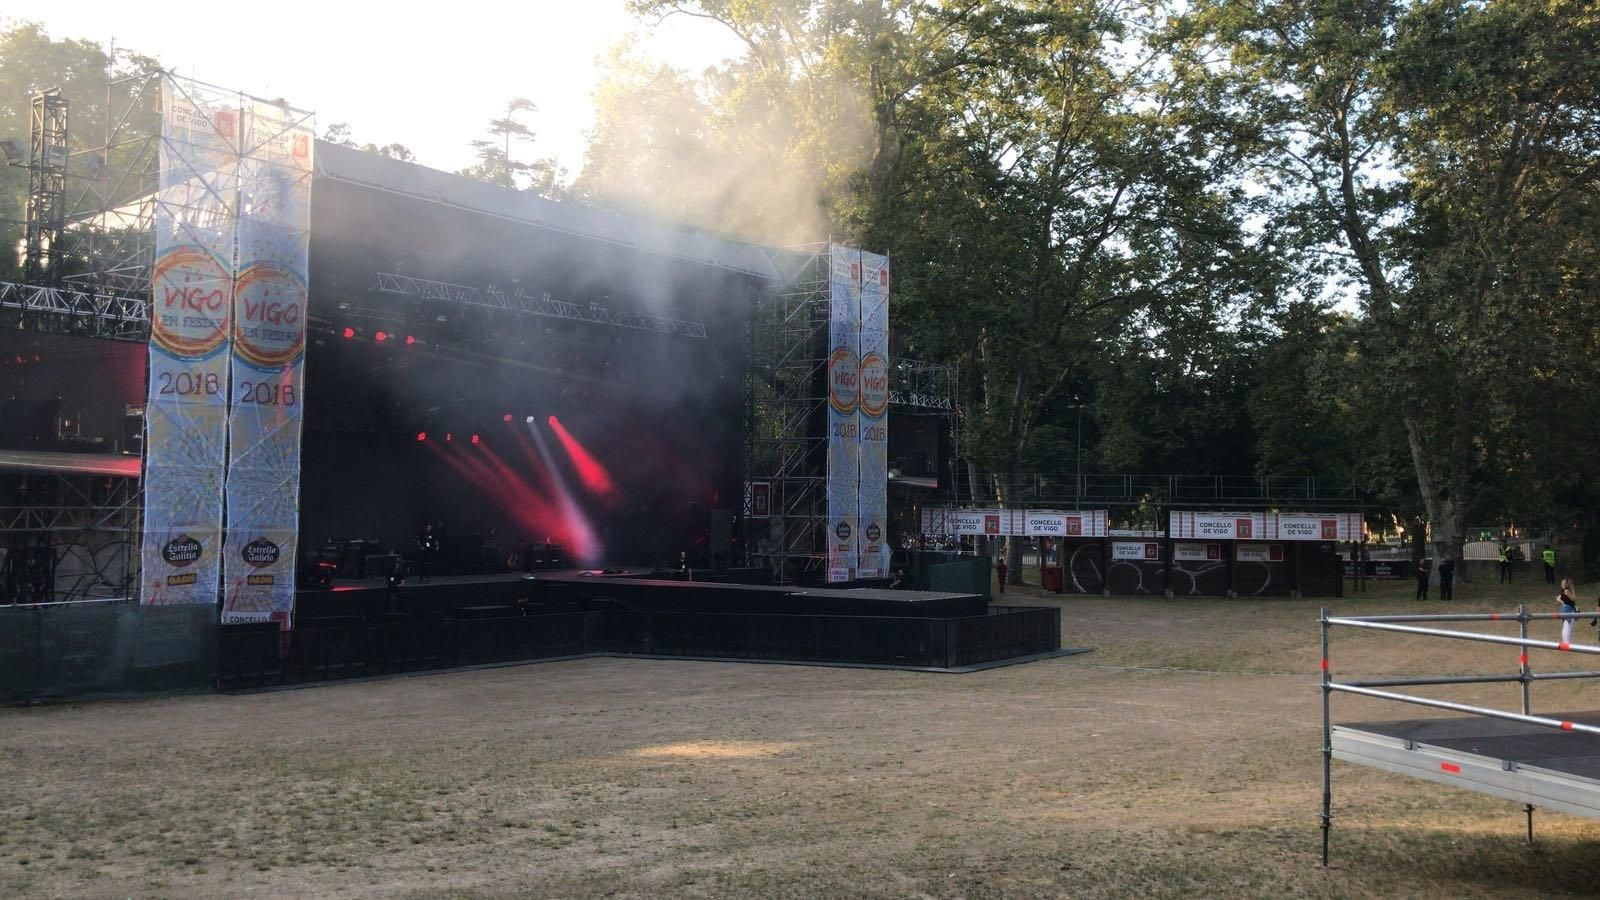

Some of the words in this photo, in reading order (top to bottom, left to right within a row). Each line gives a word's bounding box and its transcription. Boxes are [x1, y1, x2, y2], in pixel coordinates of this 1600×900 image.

[190, 117, 208, 128] VIGO
[163, 286, 223, 313] VIGO
[244, 297, 299, 327] VIGO
[159, 371, 219, 396] 2018
[834, 371, 857, 388] VIGO
[240, 381, 296, 407] 2018
[833, 422, 857, 438] 2018
[864, 426, 885, 441] 2018
[168, 543, 199, 553] Estrella
[169, 551, 197, 561] Galicia
[247, 545, 276, 554] Estrella
